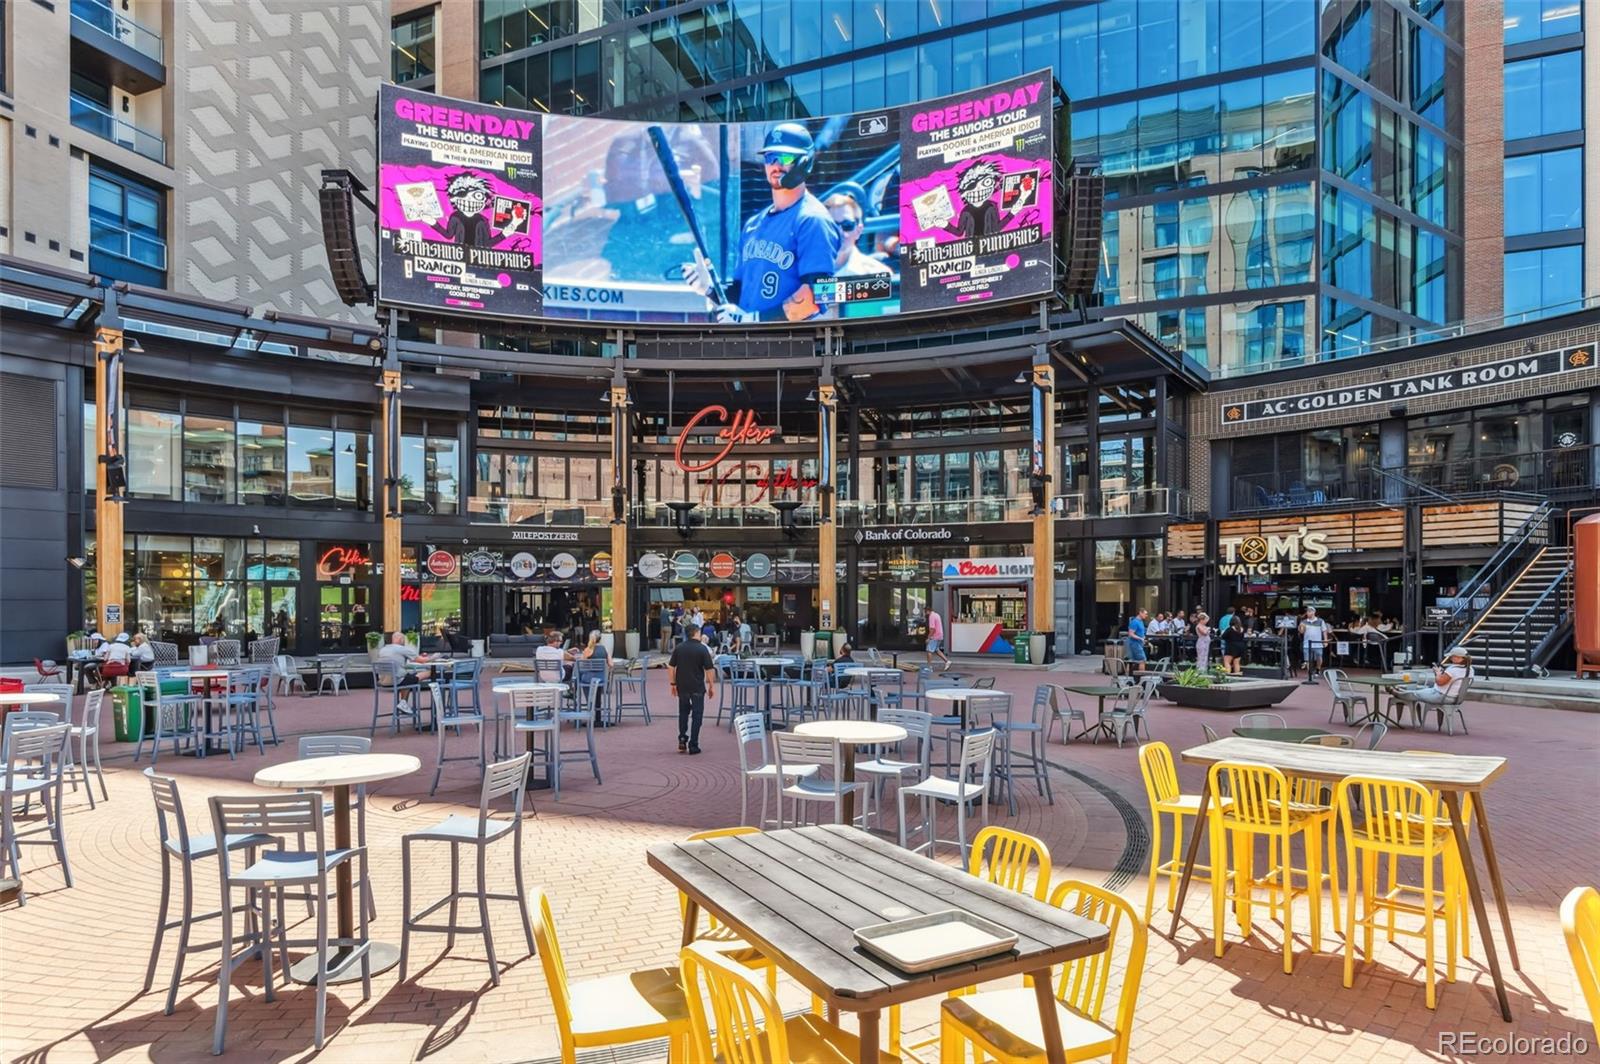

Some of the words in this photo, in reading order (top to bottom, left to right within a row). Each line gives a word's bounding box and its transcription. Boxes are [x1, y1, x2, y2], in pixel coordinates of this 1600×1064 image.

[416, 123, 438, 138] THE
[441, 128, 485, 147] SAVIORS
[487, 136, 518, 150] TOUR
[919, 147, 942, 156] PLAYING
[943, 138, 971, 151] DOOKIE
[979, 127, 1017, 141] AMERICAN
[1018, 120, 1040, 131] IDIOT
[930, 129, 950, 142] THE
[952, 118, 994, 137] SAVIORS
[996, 108, 1027, 122] TOUR
[403, 137, 429, 148] PLAYING
[430, 141, 462, 153] DOOKIE
[469, 148, 508, 161] AMERICAN
[509, 153, 531, 163] IDIOT
[962, 147, 977, 155] THEIR
[977, 141, 1001, 151] ENTIRETY
[467, 158, 493, 166] ENTIRETY
[402, 239, 464, 261] SMASHING
[469, 248, 532, 269] PUMPKINS
[918, 241, 974, 263] SMASHING
[979, 227, 1040, 254] PUMPKINS
[416, 260, 463, 276] RANCID
[930, 260, 972, 275] RANCID
[761, 271, 779, 299] 9
[1390, 375, 1453, 397] TANK
[1461, 359, 1538, 385] ROOM
[865, 529, 891, 540] Bank
[891, 528, 904, 540] of
[904, 527, 952, 540] Colorado
[959, 560, 998, 576] Coors
[999, 564, 1034, 575] LIGHT
[1219, 562, 1282, 576] WATCH
[1290, 561, 1330, 574] BAR
